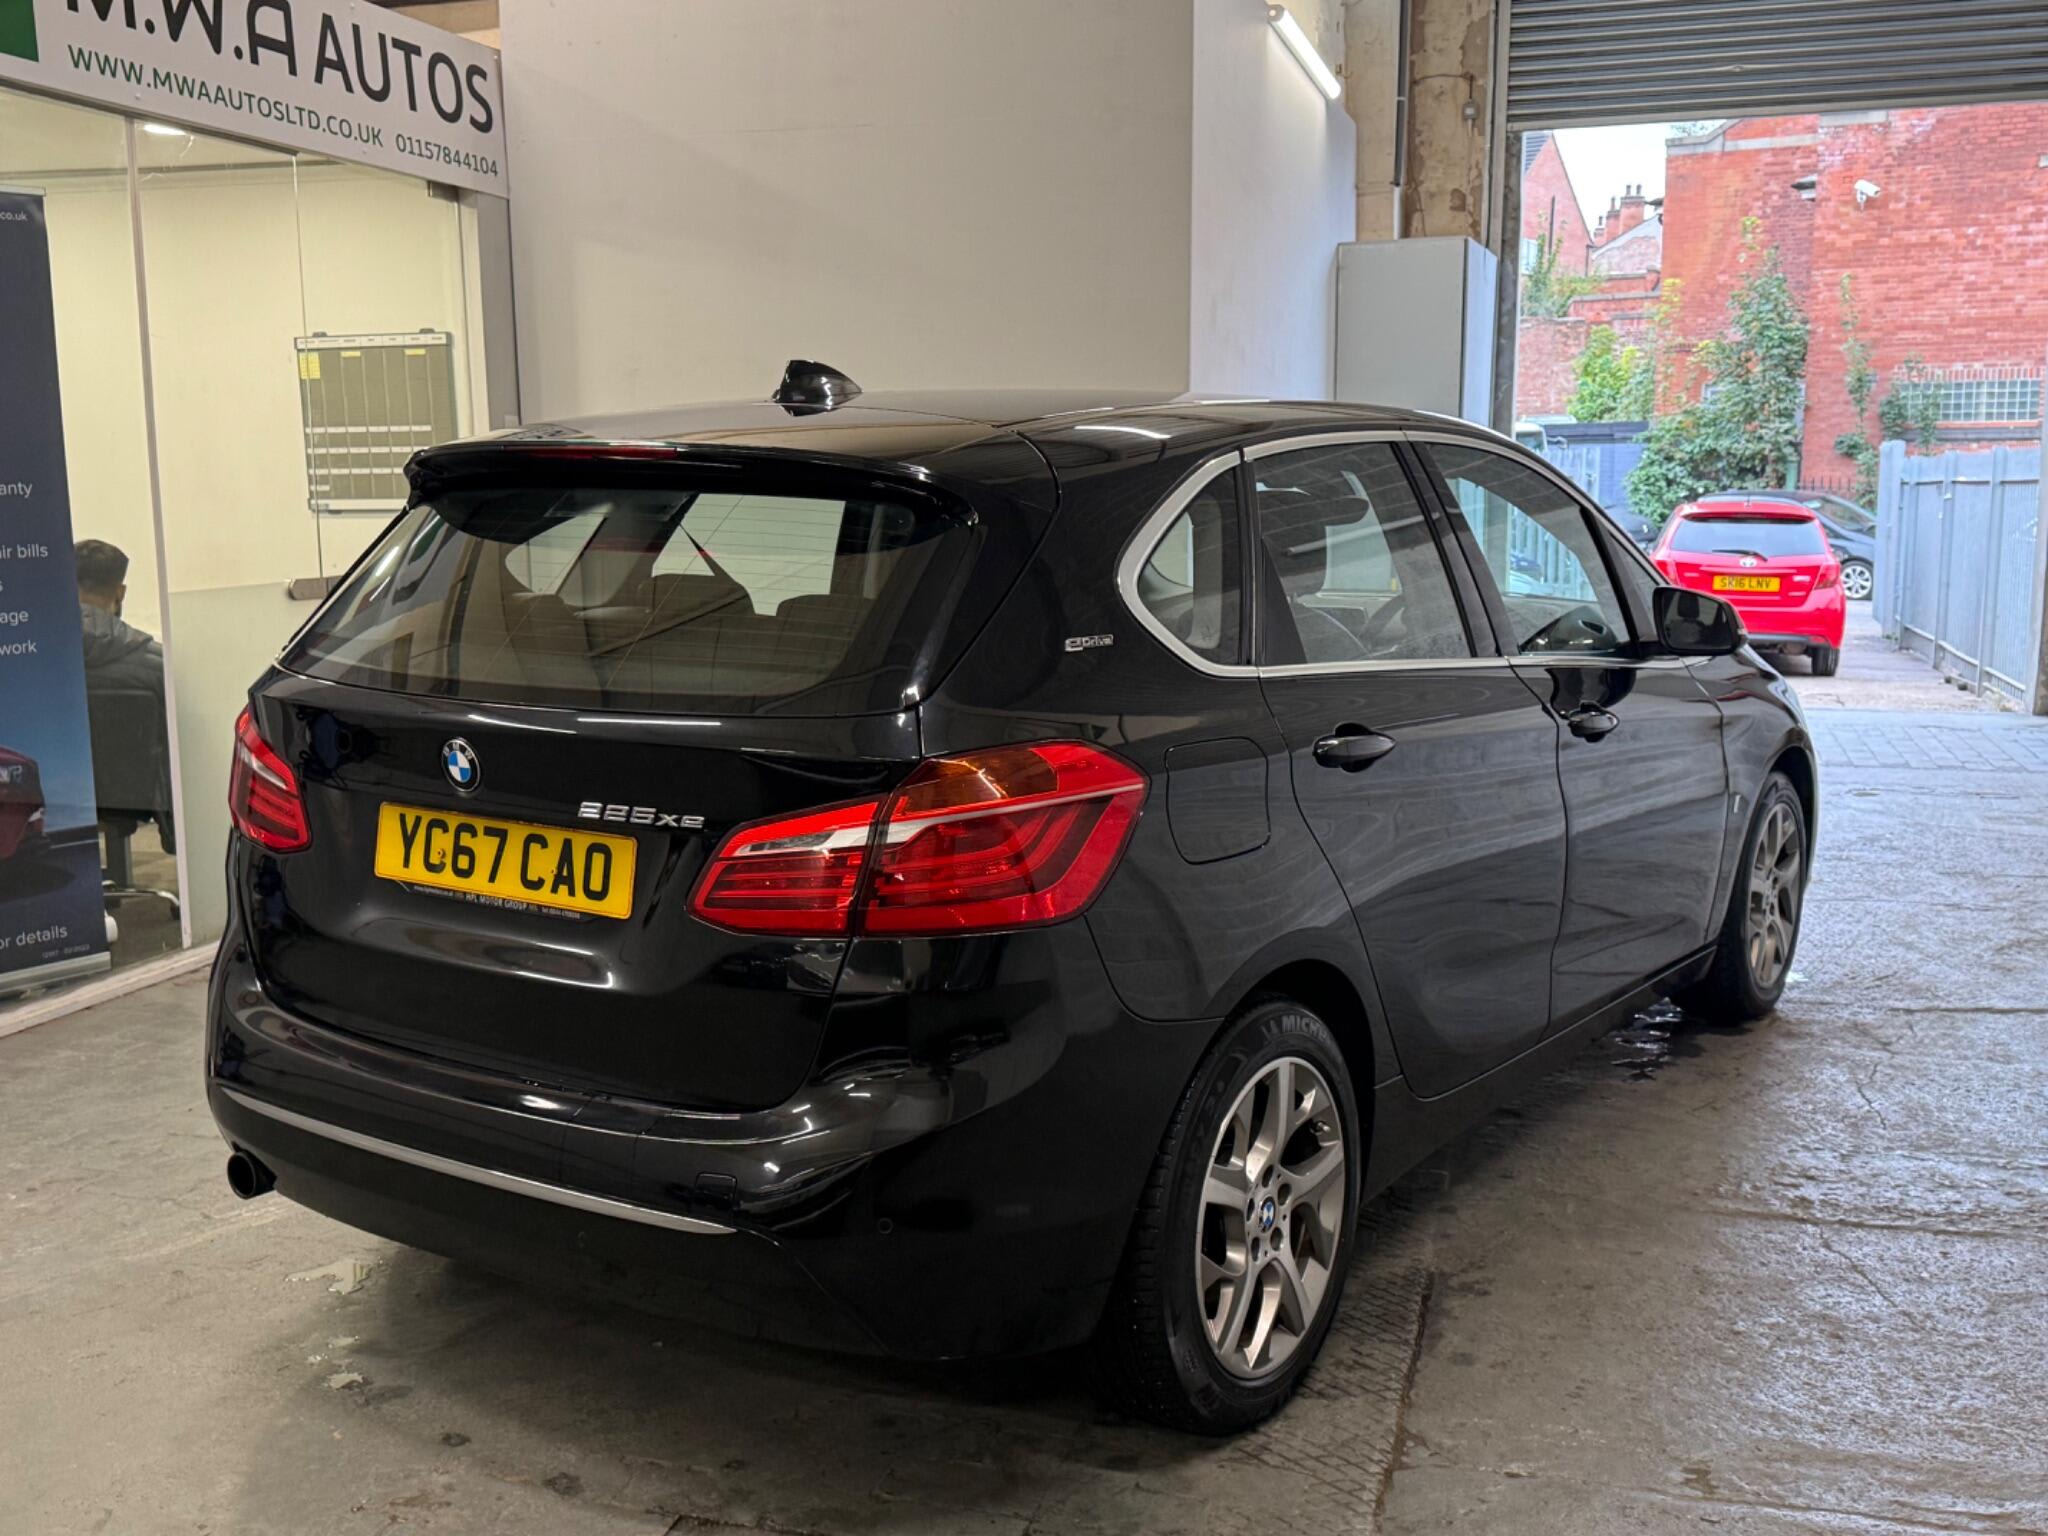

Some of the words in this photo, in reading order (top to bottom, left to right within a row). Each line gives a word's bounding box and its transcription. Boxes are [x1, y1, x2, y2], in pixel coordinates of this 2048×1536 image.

[67, 44, 384, 148] WWW.MWAAUTOSLTD.CO.UK
[394, 133, 499, 177] 01157844104
[313, 13, 494, 134] AUTOS
[16, 543, 49, 559] bills
[398, 812, 509, 885] YC67
[519, 832, 614, 902] CAO
[15, 924, 69, 947] details
